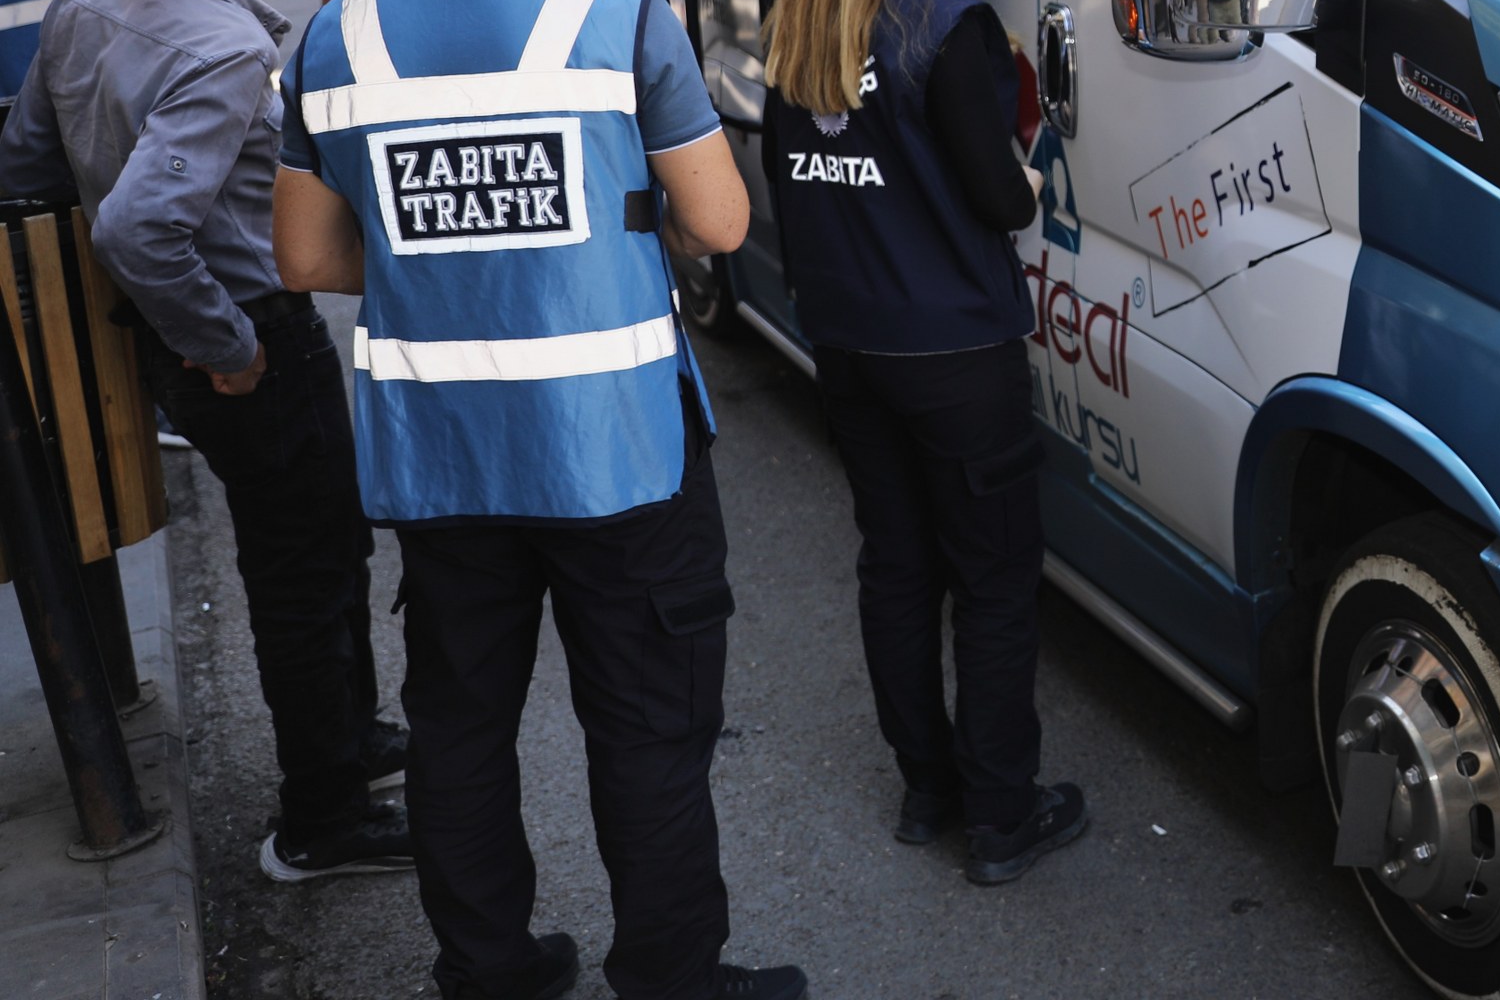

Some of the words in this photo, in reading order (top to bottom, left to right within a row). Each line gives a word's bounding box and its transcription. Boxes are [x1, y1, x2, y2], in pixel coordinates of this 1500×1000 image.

[394, 142, 558, 190] ZABITA
[787, 152, 885, 186] ZABITA
[1148, 195, 1208, 259] The
[1210, 141, 1291, 227] First
[400, 186, 563, 232] TRAFİK
[1022, 249, 1130, 399] deal
[1049, 373, 1141, 486] kursu
